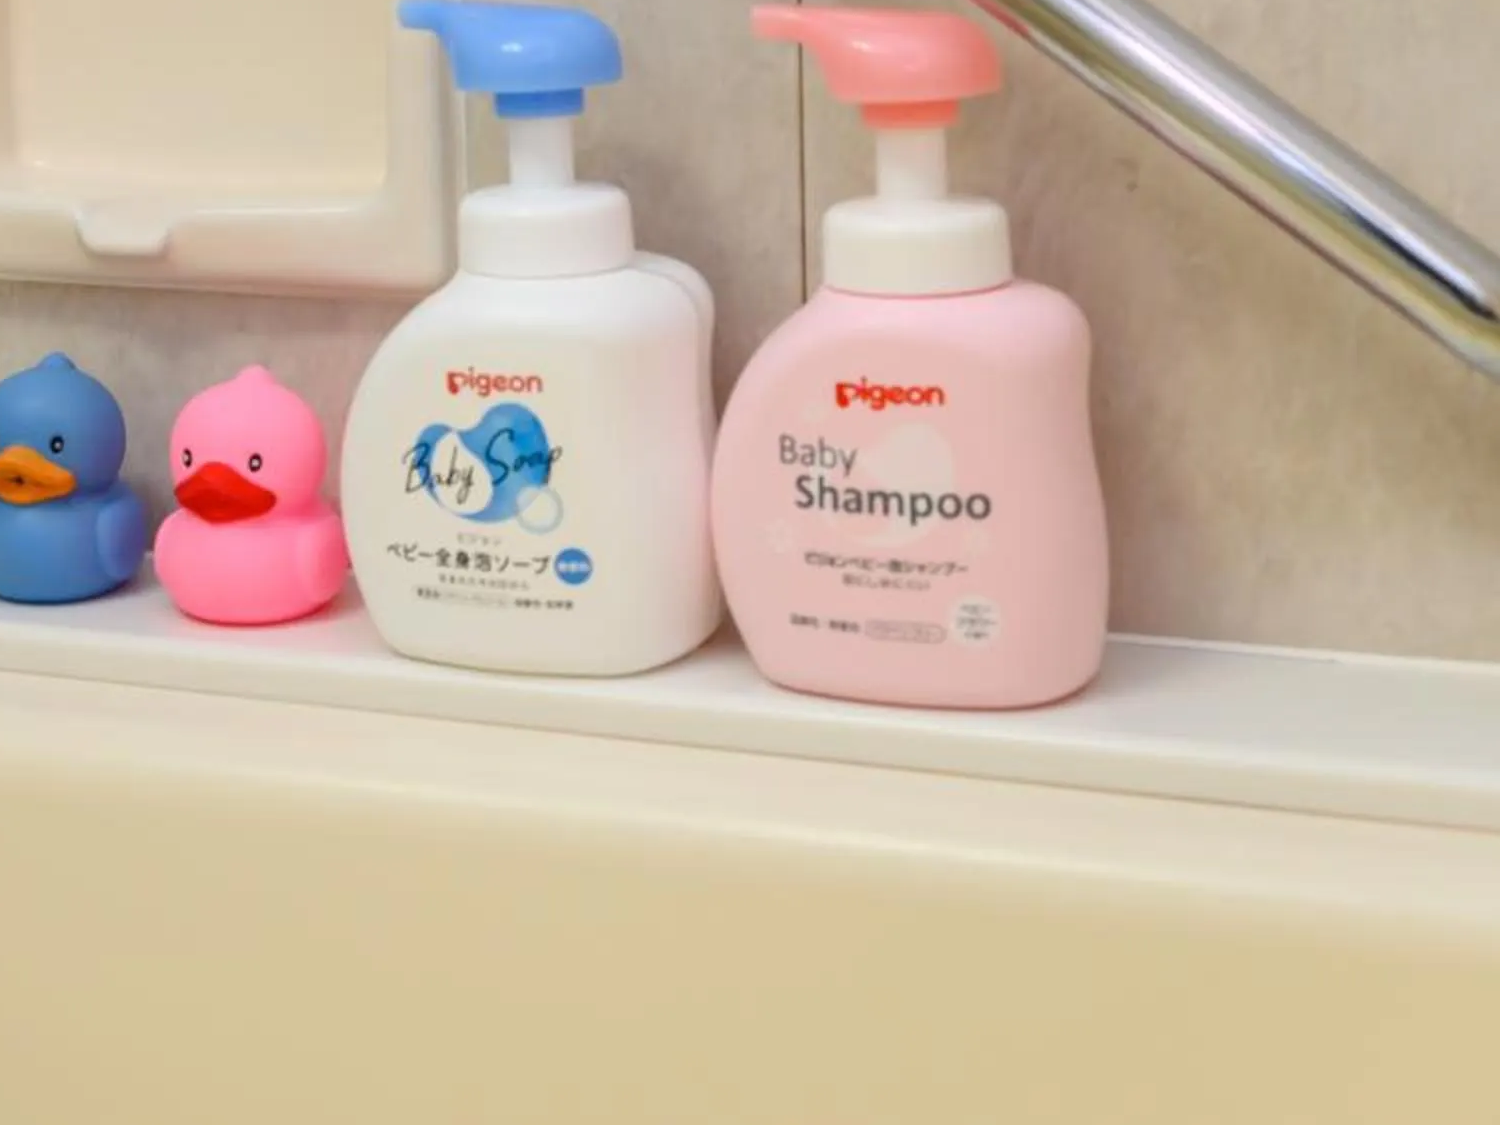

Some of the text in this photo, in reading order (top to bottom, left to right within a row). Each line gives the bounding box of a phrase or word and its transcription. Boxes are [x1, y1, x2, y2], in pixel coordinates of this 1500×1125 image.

[402, 442, 475, 504] Baby
[778, 432, 858, 477] Baby
[794, 474, 992, 527] Shampoo
